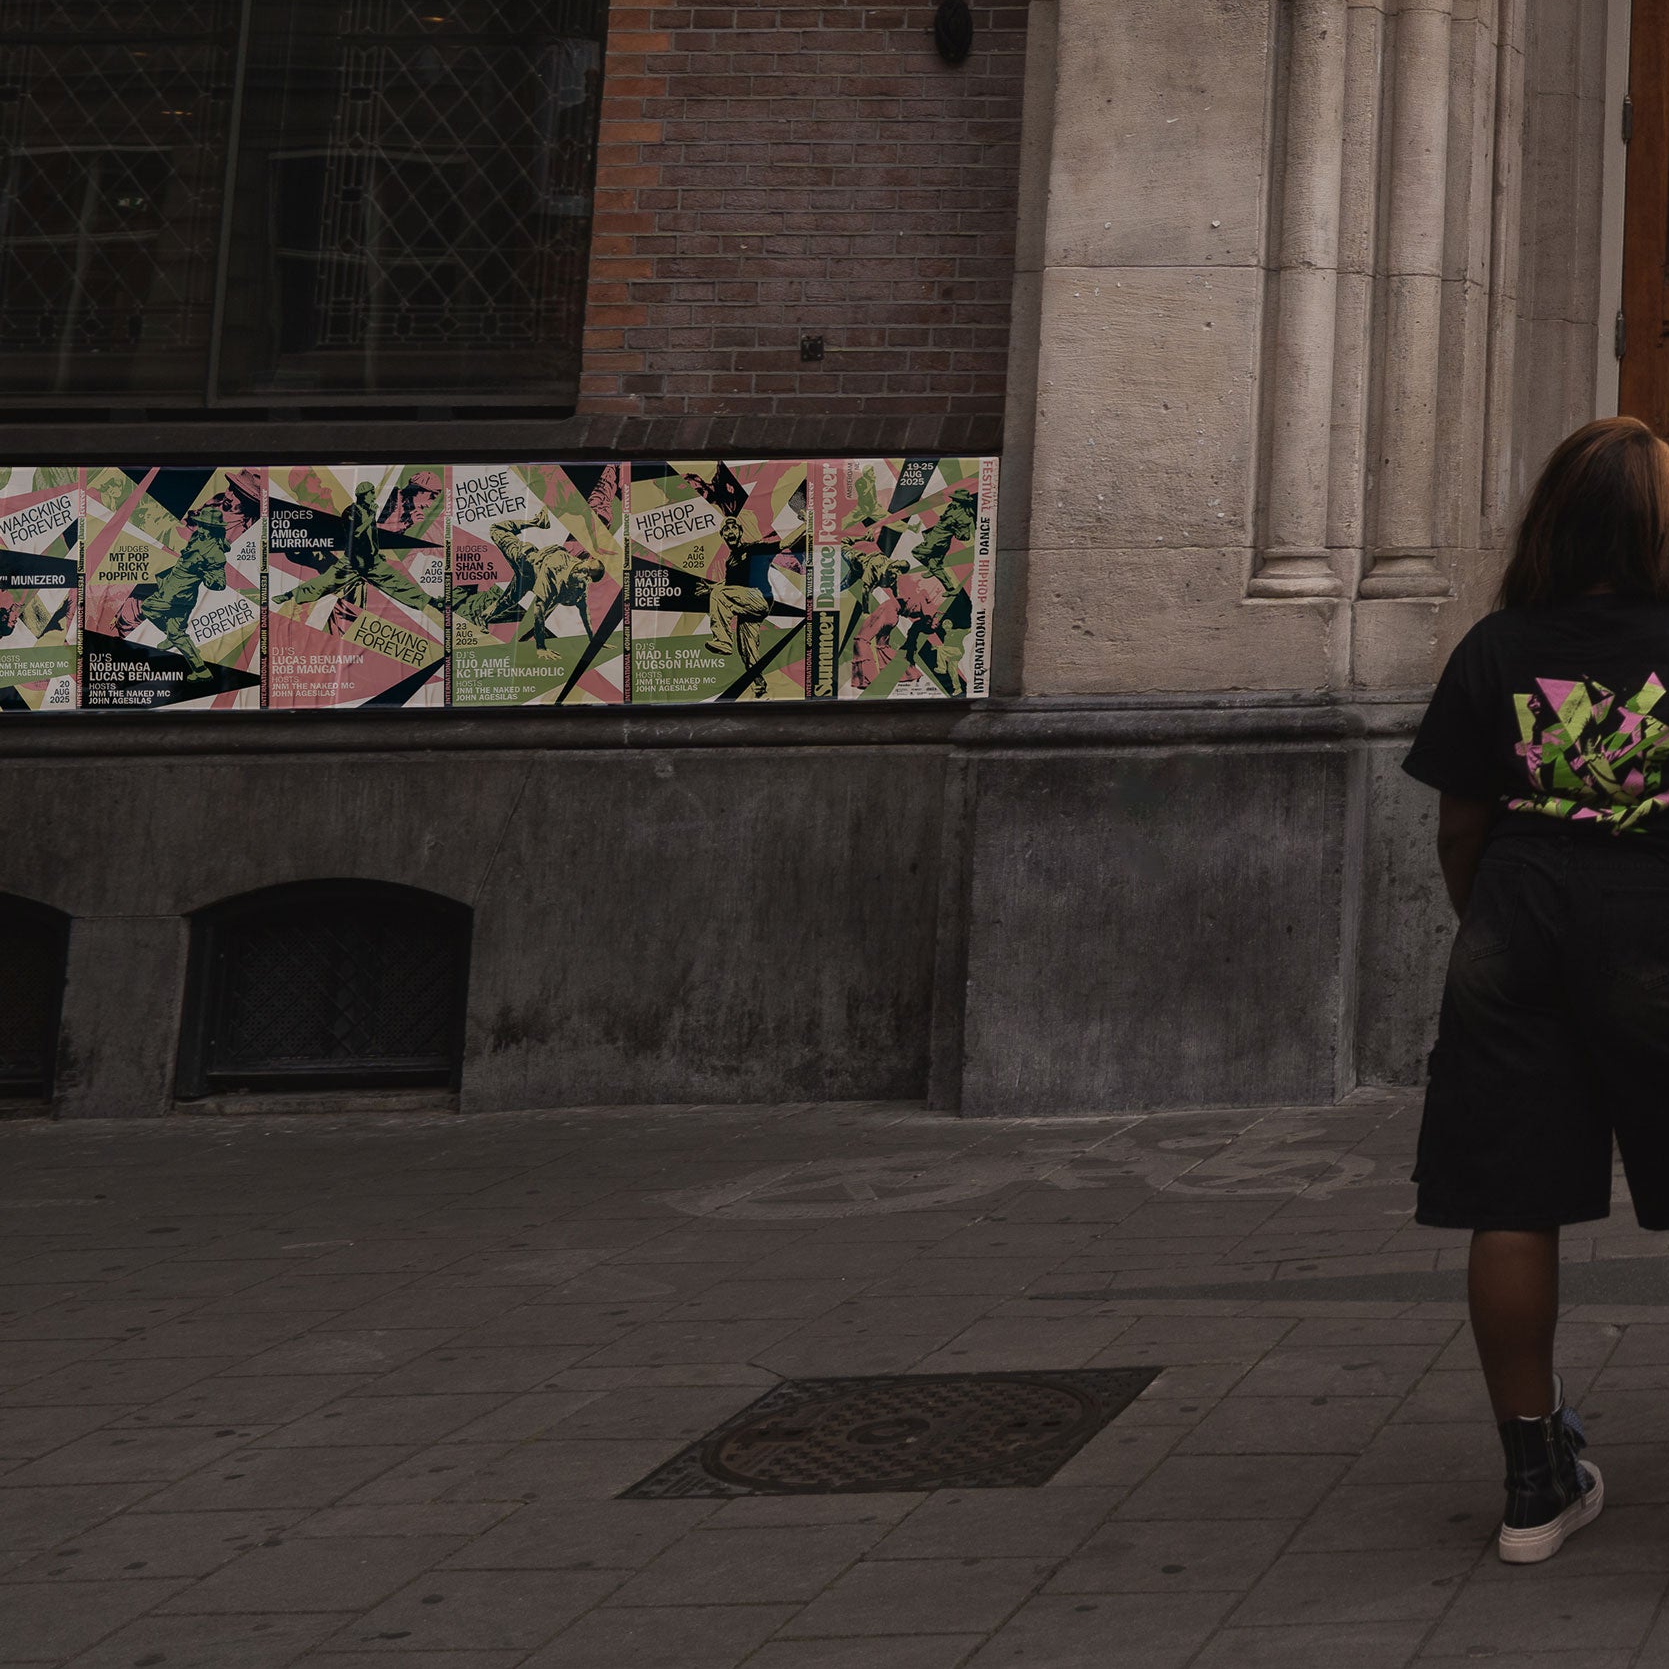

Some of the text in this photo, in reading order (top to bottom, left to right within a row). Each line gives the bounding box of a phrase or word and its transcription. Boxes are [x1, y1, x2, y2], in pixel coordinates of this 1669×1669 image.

[907, 462, 934, 470] 19-25
[903, 470, 923, 478] AUG
[455, 471, 510, 497] HOUSE
[900, 478, 925, 486] 2025
[455, 486, 510, 511] DANCE
[0, 495, 72, 535] WAACKING
[271, 510, 314, 520] JUDGES
[456, 496, 527, 525] FOREVER
[635, 503, 696, 531] HIPHOP
[10, 510, 73, 545] FOREVER
[271, 519, 291, 529] CIO
[643, 513, 716, 543] FOREVER
[271, 529, 308, 539] AMIGO
[271, 538, 335, 548] HURRIKANE
[118, 545, 150, 553] JUDGES
[109, 553, 150, 562] MT POP
[456, 553, 481, 562] HIRO
[117, 562, 150, 571] RICKY
[456, 562, 494, 571] SHAN S
[99, 571, 150, 581] POPPIN C
[455, 571, 498, 580] YUGSON
[634, 569, 669, 578] JUDGES
[973, 460, 994, 694] INTERNATIONAL HIPHOP DANCE FESTIVAL
[11, 575, 66, 587] MUNEZERO
[634, 578, 670, 587] MAJID
[814, 462, 838, 697] Summer Dance Forever
[634, 587, 682, 597] BOUBOO
[635, 597, 661, 607] ICEE
[191, 598, 250, 631] POPPING
[194, 608, 256, 642] FOREVER
[456, 623, 467, 631] 23
[360, 616, 429, 654] LOCKING
[456, 630, 473, 638] AUG
[456, 638, 478, 646] 2025
[353, 629, 425, 667] FOREVER
[89, 653, 113, 662] DJ'S
[635, 650, 701, 660] MAD L SOW
[89, 662, 151, 671] NOBUNAGA
[456, 657, 511, 669] TIJO AIMÉ
[635, 659, 726, 670] YUGSON HAWKS
[89, 671, 184, 681] LUCAS BENJAMIN
[456, 667, 565, 678] KC THE FUNKAHOLIC
